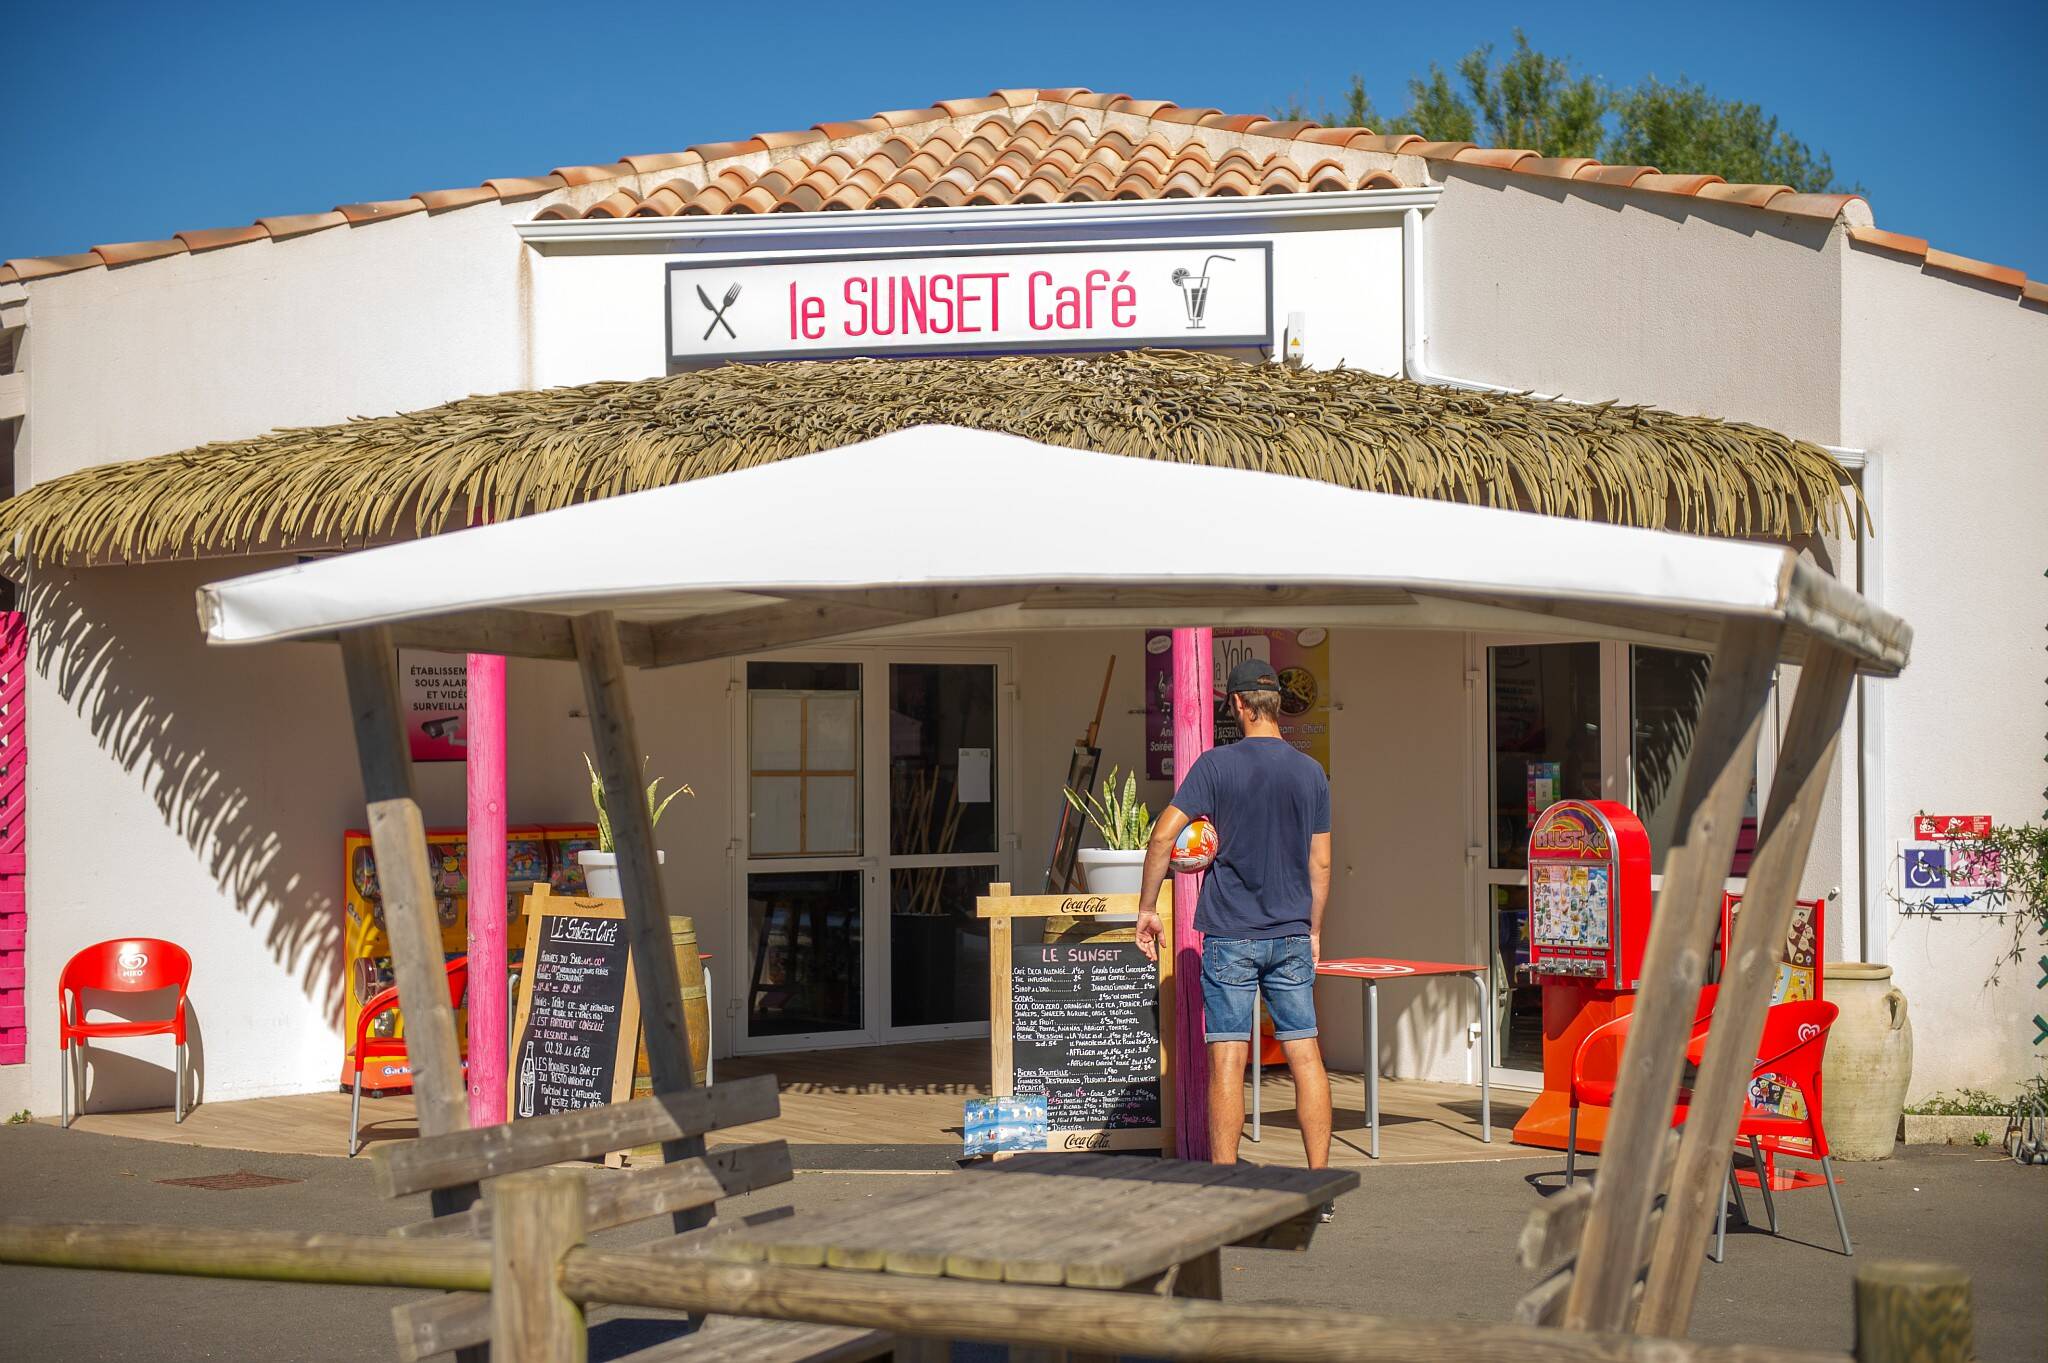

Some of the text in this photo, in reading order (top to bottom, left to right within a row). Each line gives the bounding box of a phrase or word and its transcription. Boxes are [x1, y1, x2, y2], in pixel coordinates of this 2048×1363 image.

[789, 268, 1137, 341] le SUNSET Café
[410, 664, 467, 676] ÉTABLISSEM
[415, 679, 467, 687] SOUS ALAR
[426, 691, 438, 699] ET
[413, 702, 467, 711] SURVEILLA
[1060, 897, 1108, 913] Coca-Cola
[550, 916, 568, 938] LE
[1042, 948, 1122, 963] LE SUNSET
[1064, 1133, 1111, 1150] Coca-Cola
